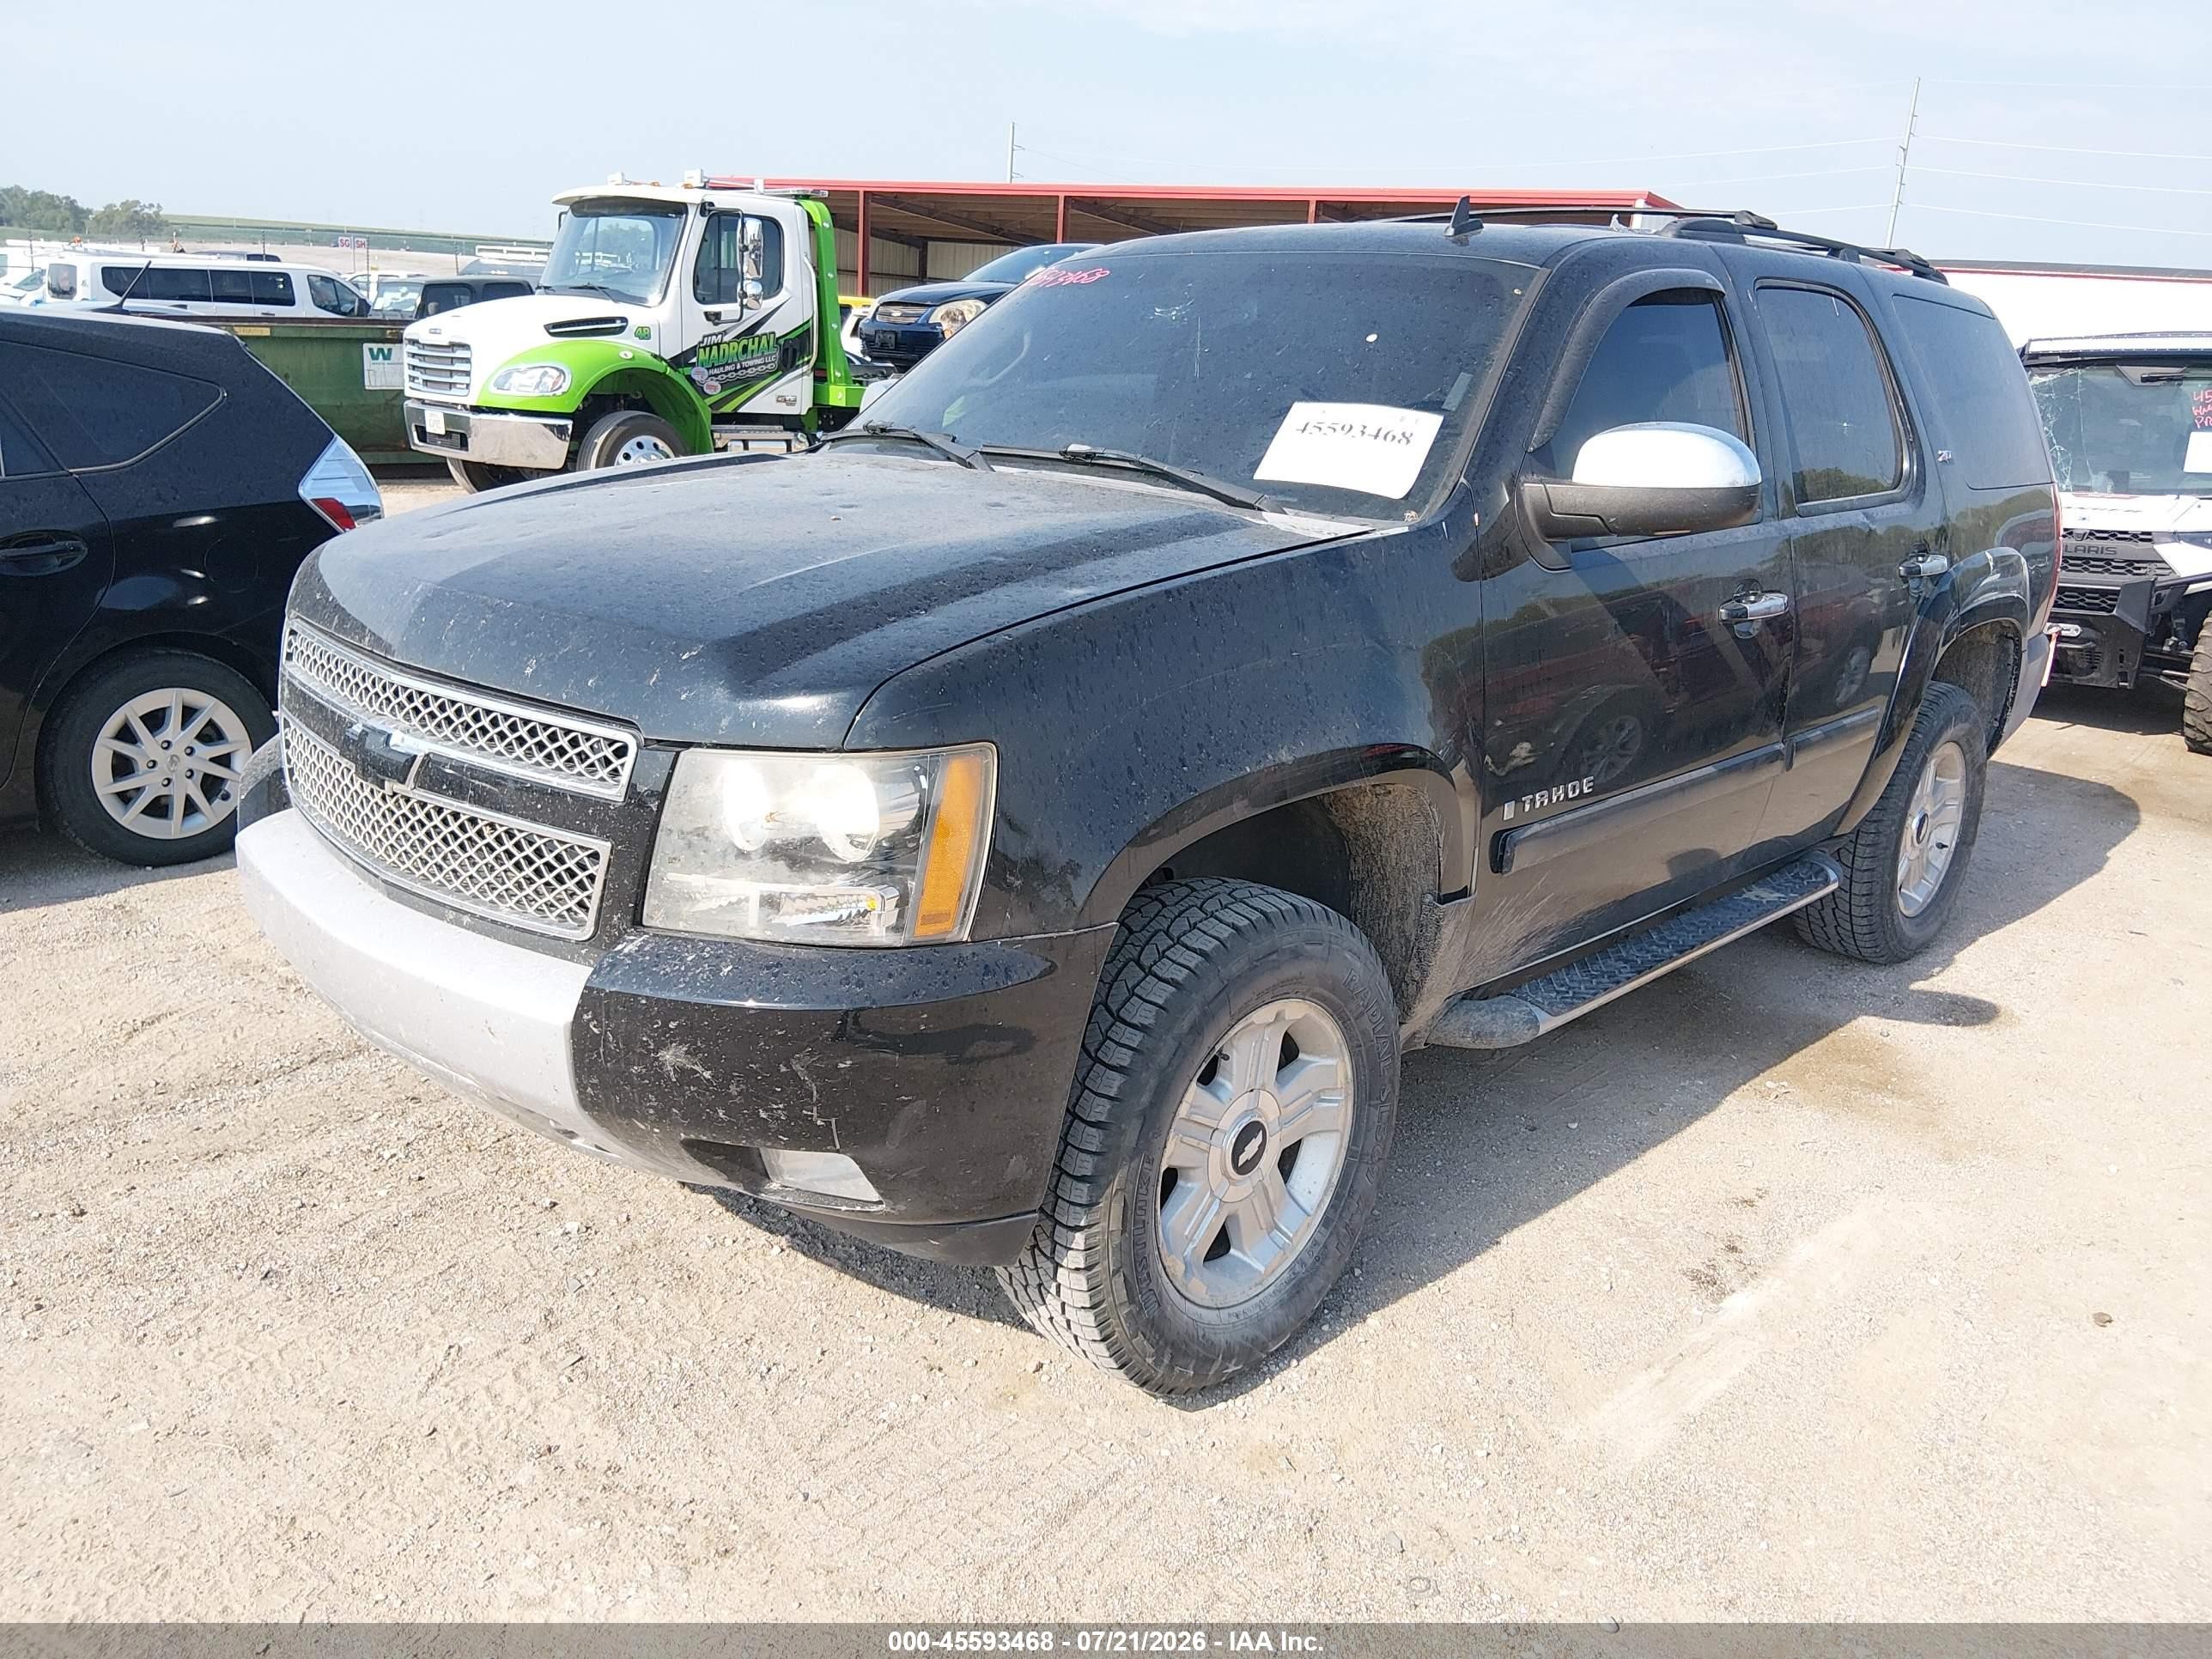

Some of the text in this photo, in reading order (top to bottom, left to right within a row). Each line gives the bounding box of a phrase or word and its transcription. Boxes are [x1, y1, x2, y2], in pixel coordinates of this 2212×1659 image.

[698, 333, 778, 368] NADRCHAL
[700, 333, 723, 346] JIM
[708, 364, 736, 375] HAULING
[742, 358, 765, 368] TOWING
[1296, 421, 1413, 446] 45593468
[2064, 544, 2117, 556] LARIS
[1522, 776, 1595, 812] TAHOE
[1341, 968, 1393, 1078] RADIAL
[1131, 1153, 1162, 1319] WESTLAKE
